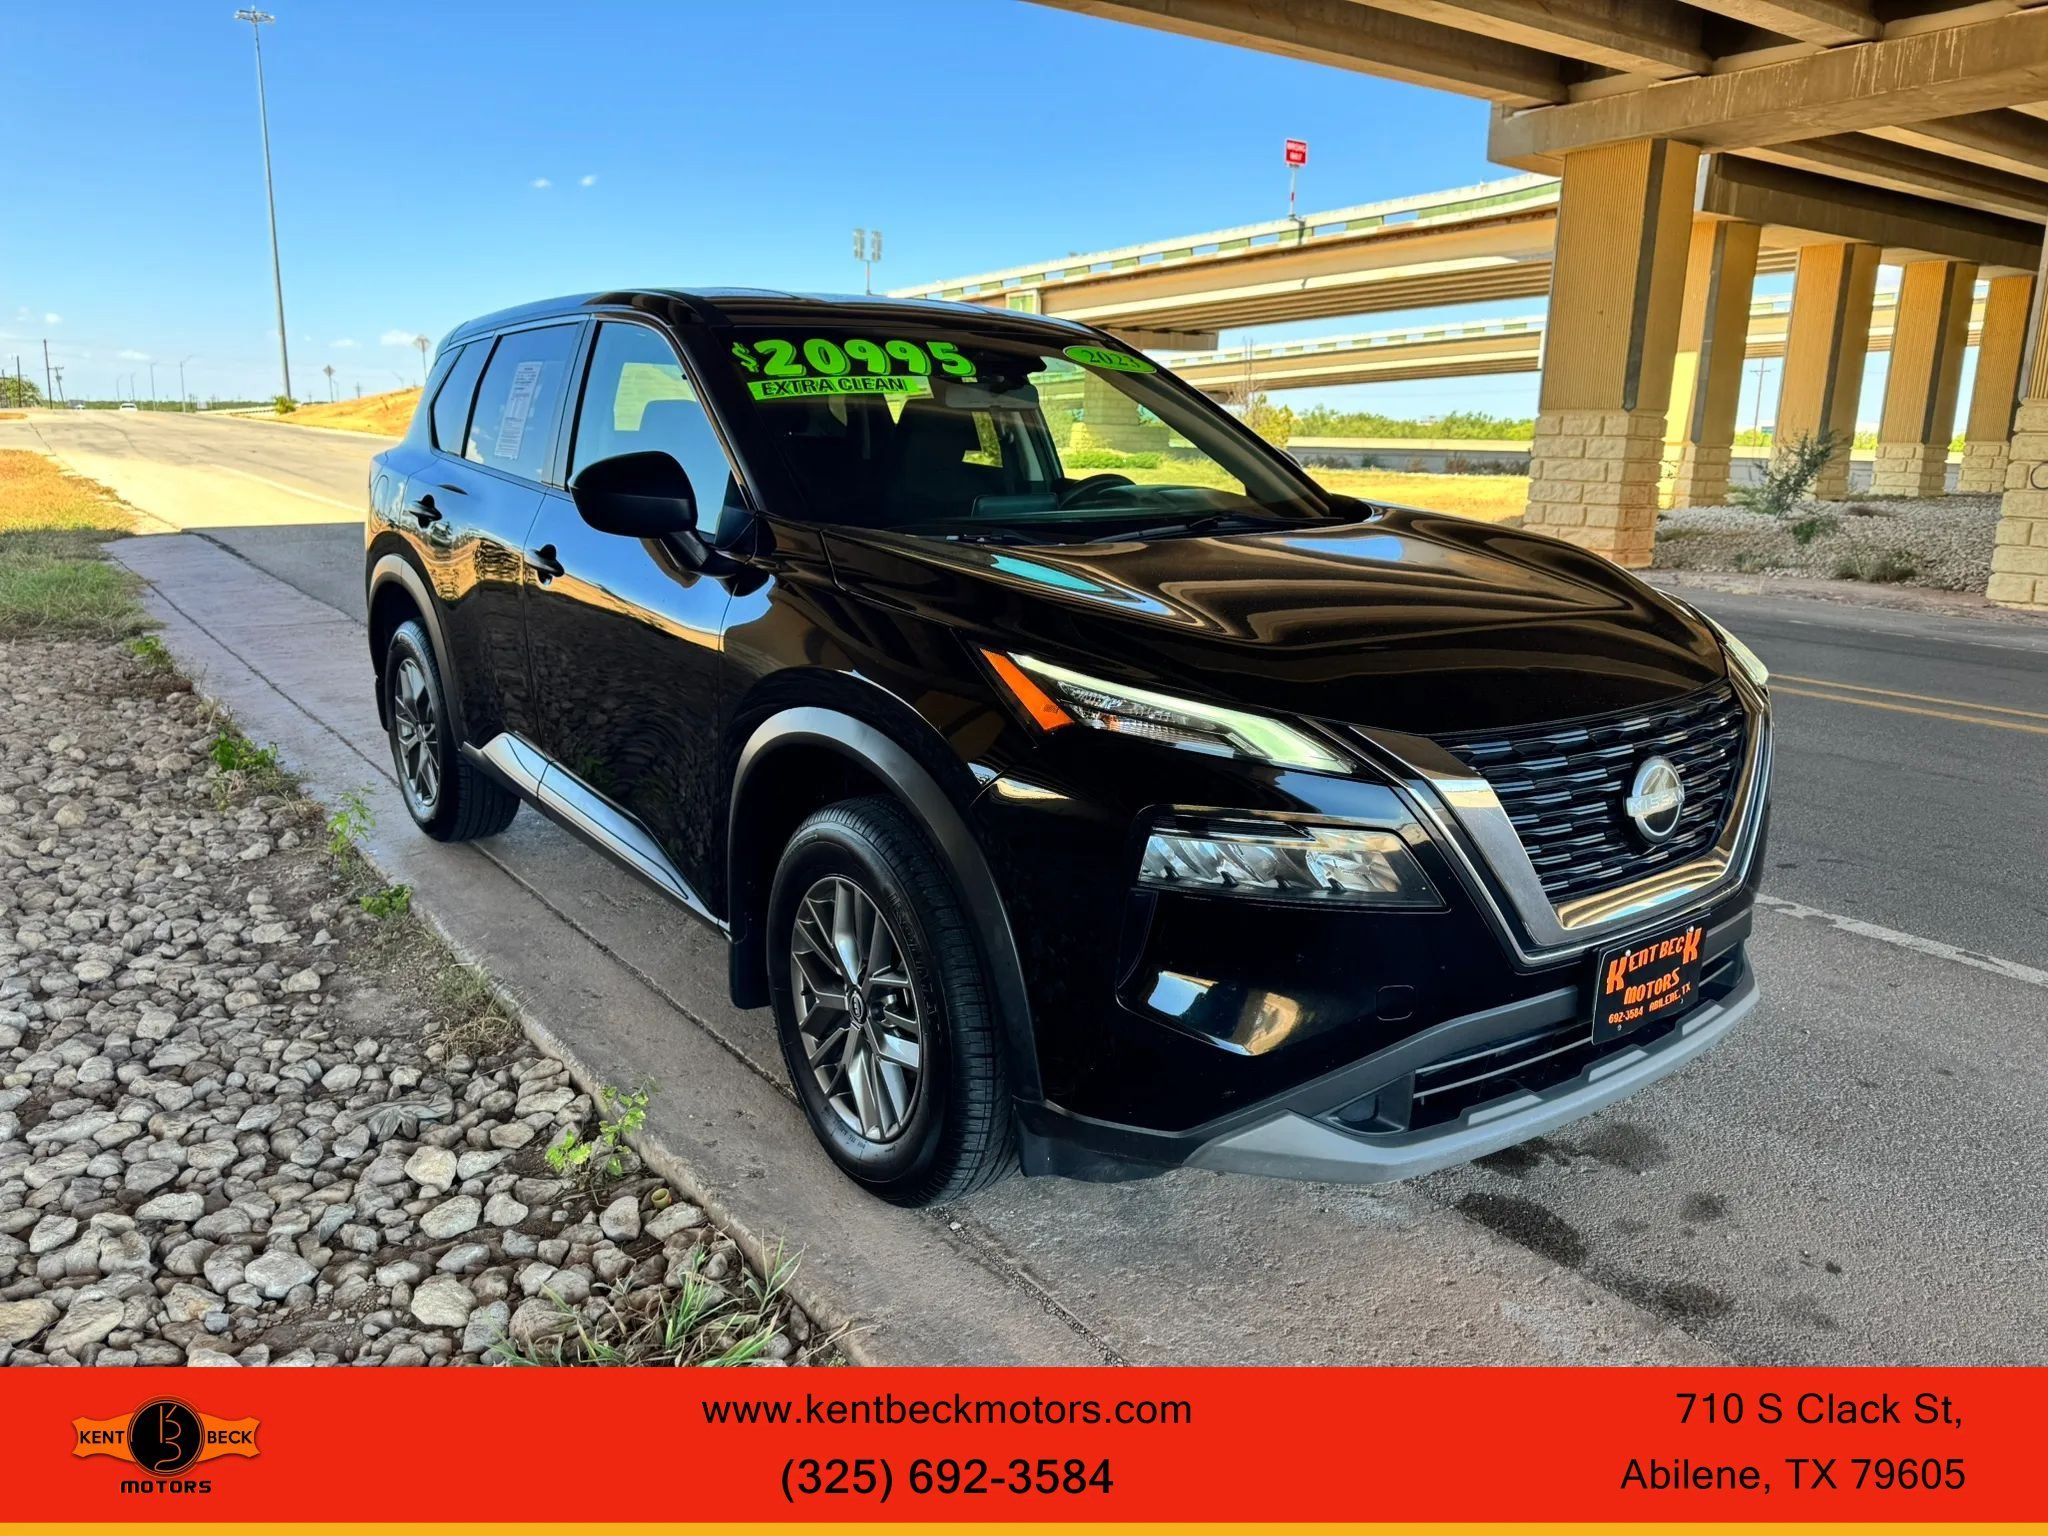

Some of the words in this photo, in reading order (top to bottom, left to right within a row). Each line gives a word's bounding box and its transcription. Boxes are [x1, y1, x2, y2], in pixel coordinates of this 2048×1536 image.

[731, 338, 977, 377] $20995
[1081, 350, 1140, 368] 2023
[761, 379, 834, 396] EXTRA
[838, 376, 908, 392] CLEAN
[1606, 943, 1659, 995] KENT
[1659, 927, 1702, 965] BECK
[1608, 1006, 1644, 1024] 692-3584
[1681, 981, 1691, 996] TX
[1623, 967, 1680, 1005] MOTORS
